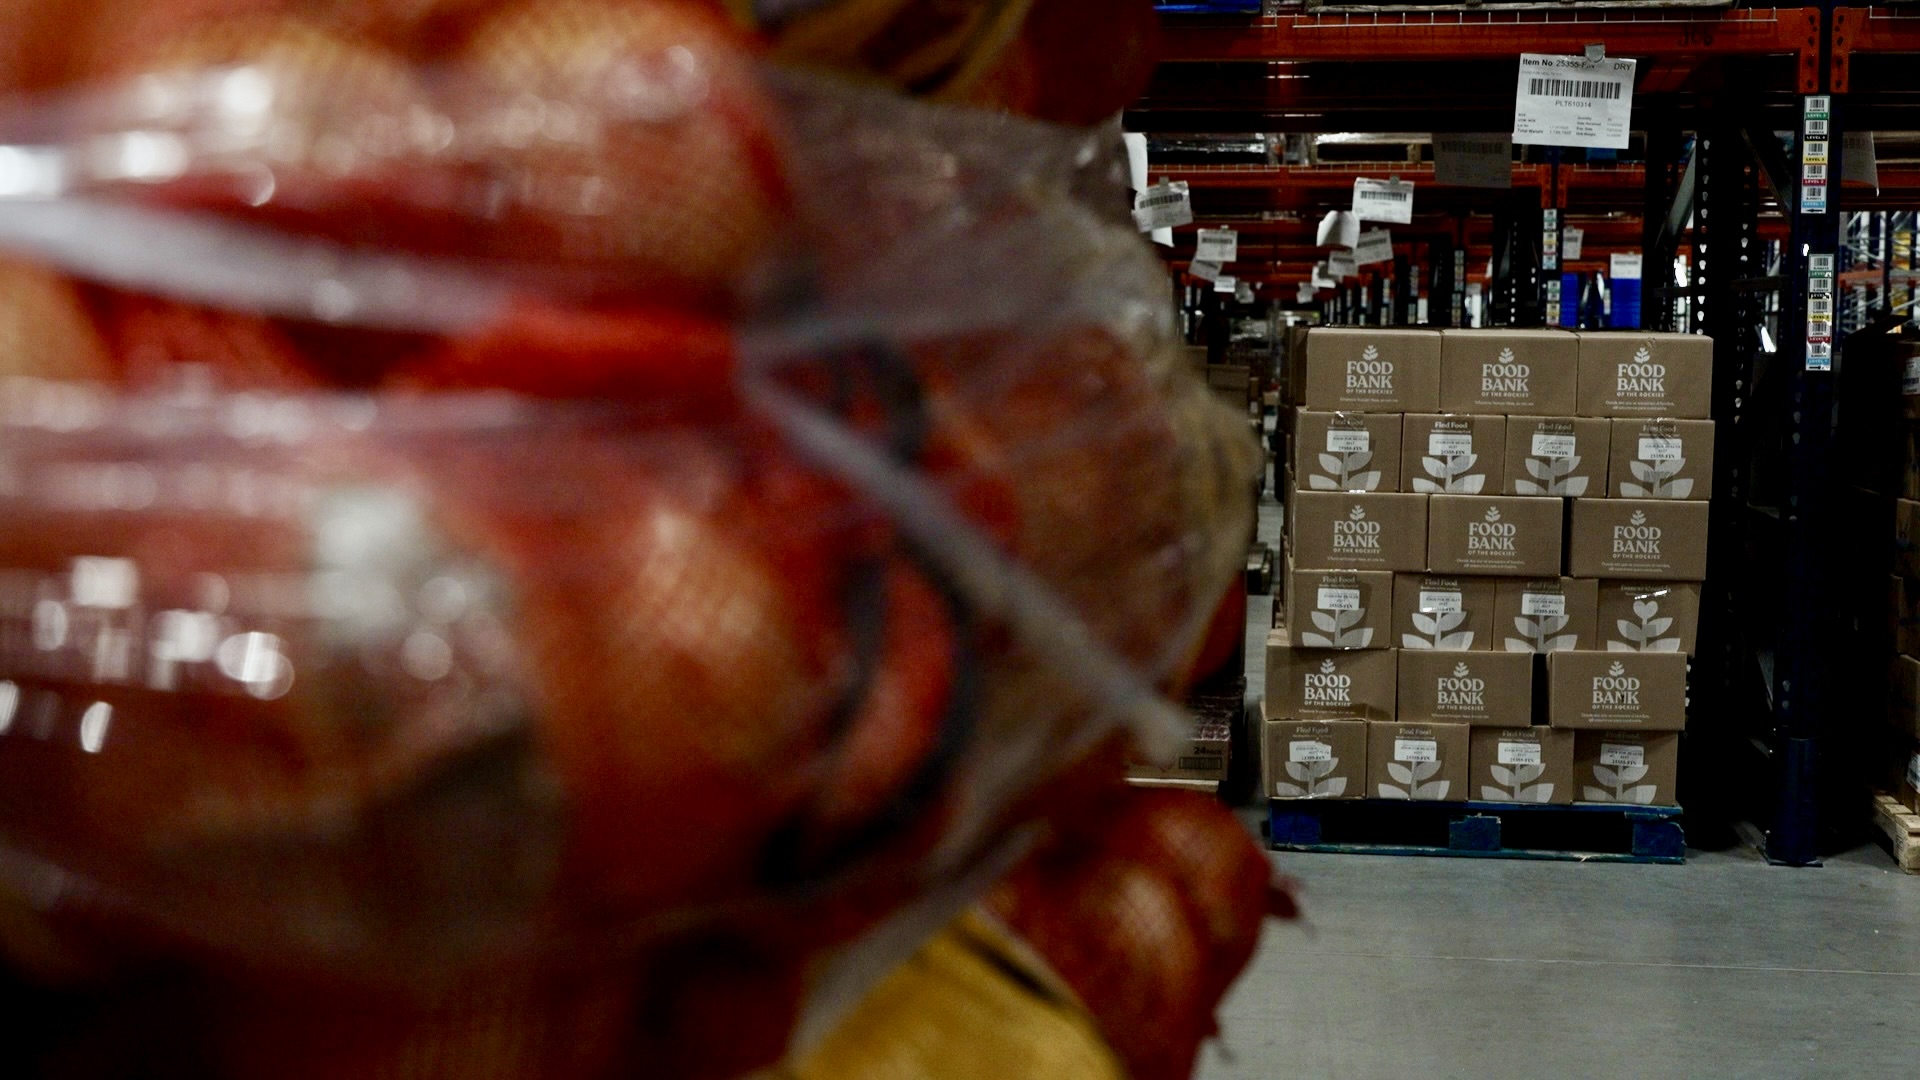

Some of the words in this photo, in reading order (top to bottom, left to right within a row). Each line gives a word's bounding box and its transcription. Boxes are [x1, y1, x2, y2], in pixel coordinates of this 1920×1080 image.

[1522, 58, 1540, 66] Item
[1347, 361, 1393, 374] FOOD
[1482, 364, 1530, 377] FOOD
[1618, 364, 1666, 378] FOOD
[1346, 375, 1392, 389] BANK
[1482, 378, 1528, 392] BANK
[1617, 378, 1664, 392] BANK
[1334, 521, 1380, 534] FOOD
[1469, 523, 1516, 536] FOOD
[1614, 526, 1661, 539] FOOD
[1334, 534, 1380, 548] BANK
[1468, 536, 1515, 550] BANK
[1613, 540, 1660, 553] BANK
[1305, 674, 1350, 688] FOOD
[1438, 678, 1485, 691] FOOD
[1593, 677, 1640, 691] FOOD
[1304, 688, 1350, 701] BANK
[1438, 691, 1483, 704] BANK
[1592, 691, 1639, 704] BANK
